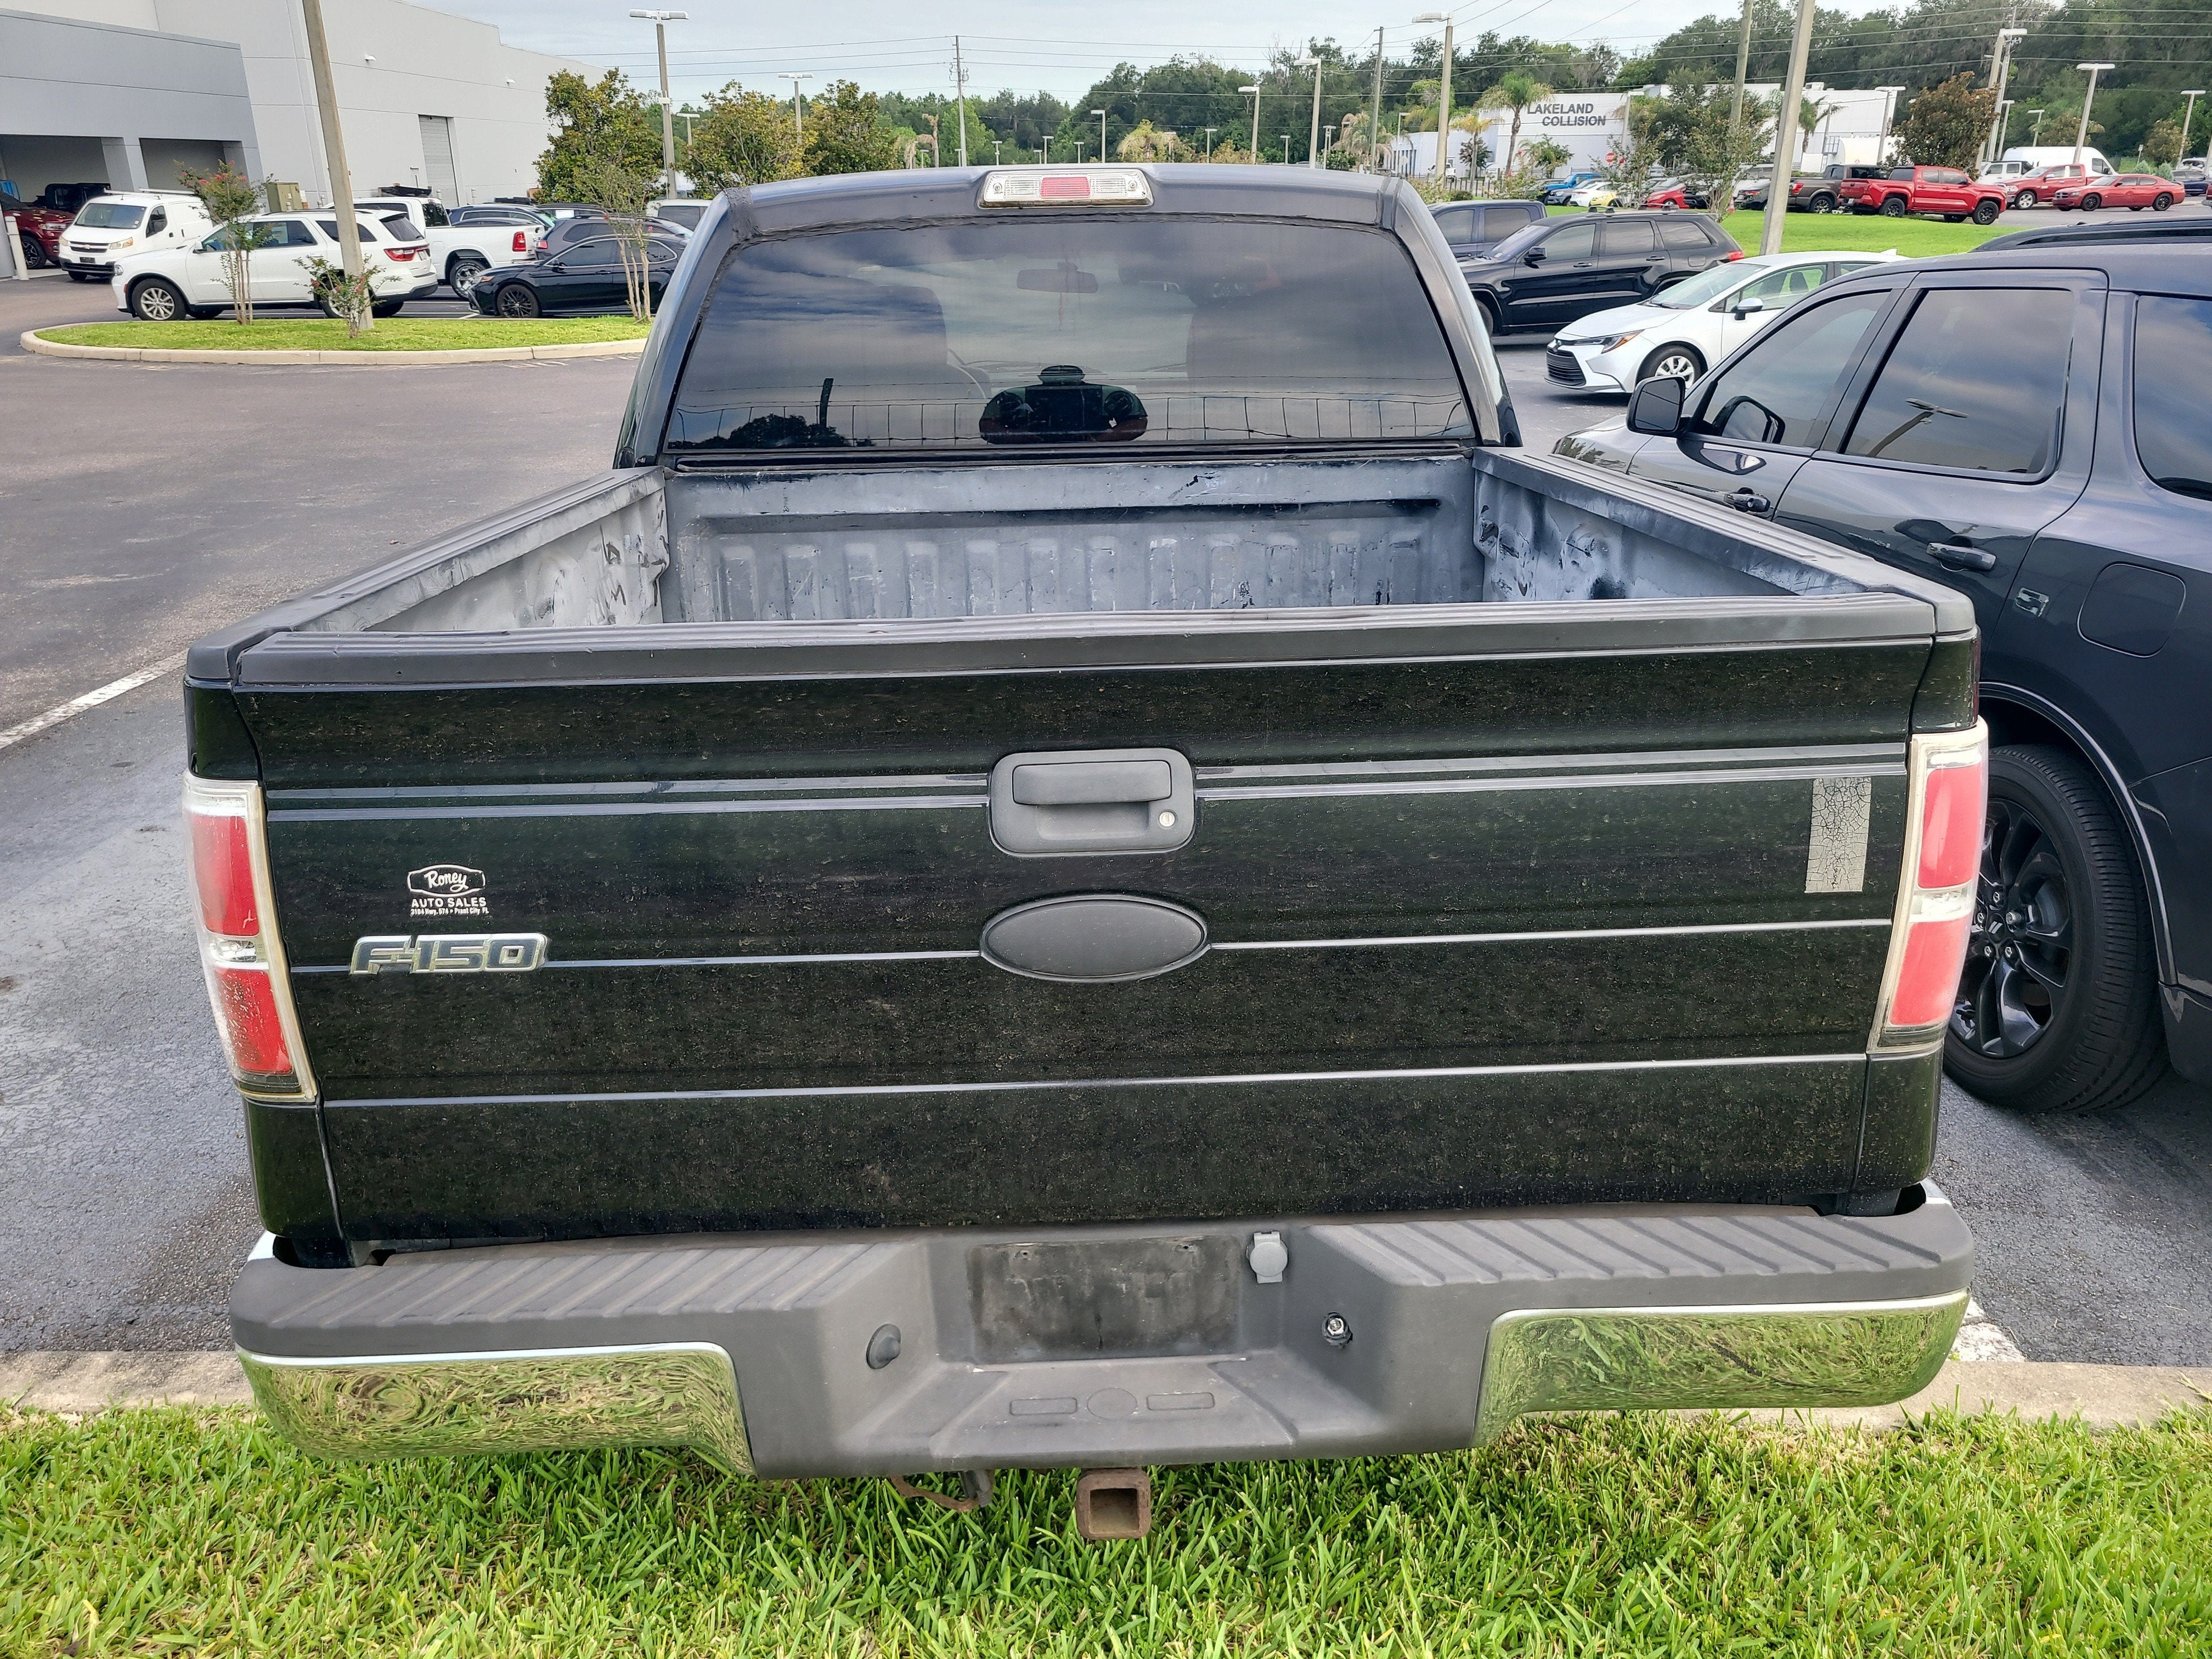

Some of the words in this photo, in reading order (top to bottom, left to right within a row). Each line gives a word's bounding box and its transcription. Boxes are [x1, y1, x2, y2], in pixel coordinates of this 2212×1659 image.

[1527, 103, 1594, 114] LAKELAND
[1542, 115, 1606, 126] COLLISION
[424, 870, 470, 893] Roney
[411, 898, 444, 908] AUTO
[447, 897, 487, 908] SALES
[349, 933, 550, 975] F-150
